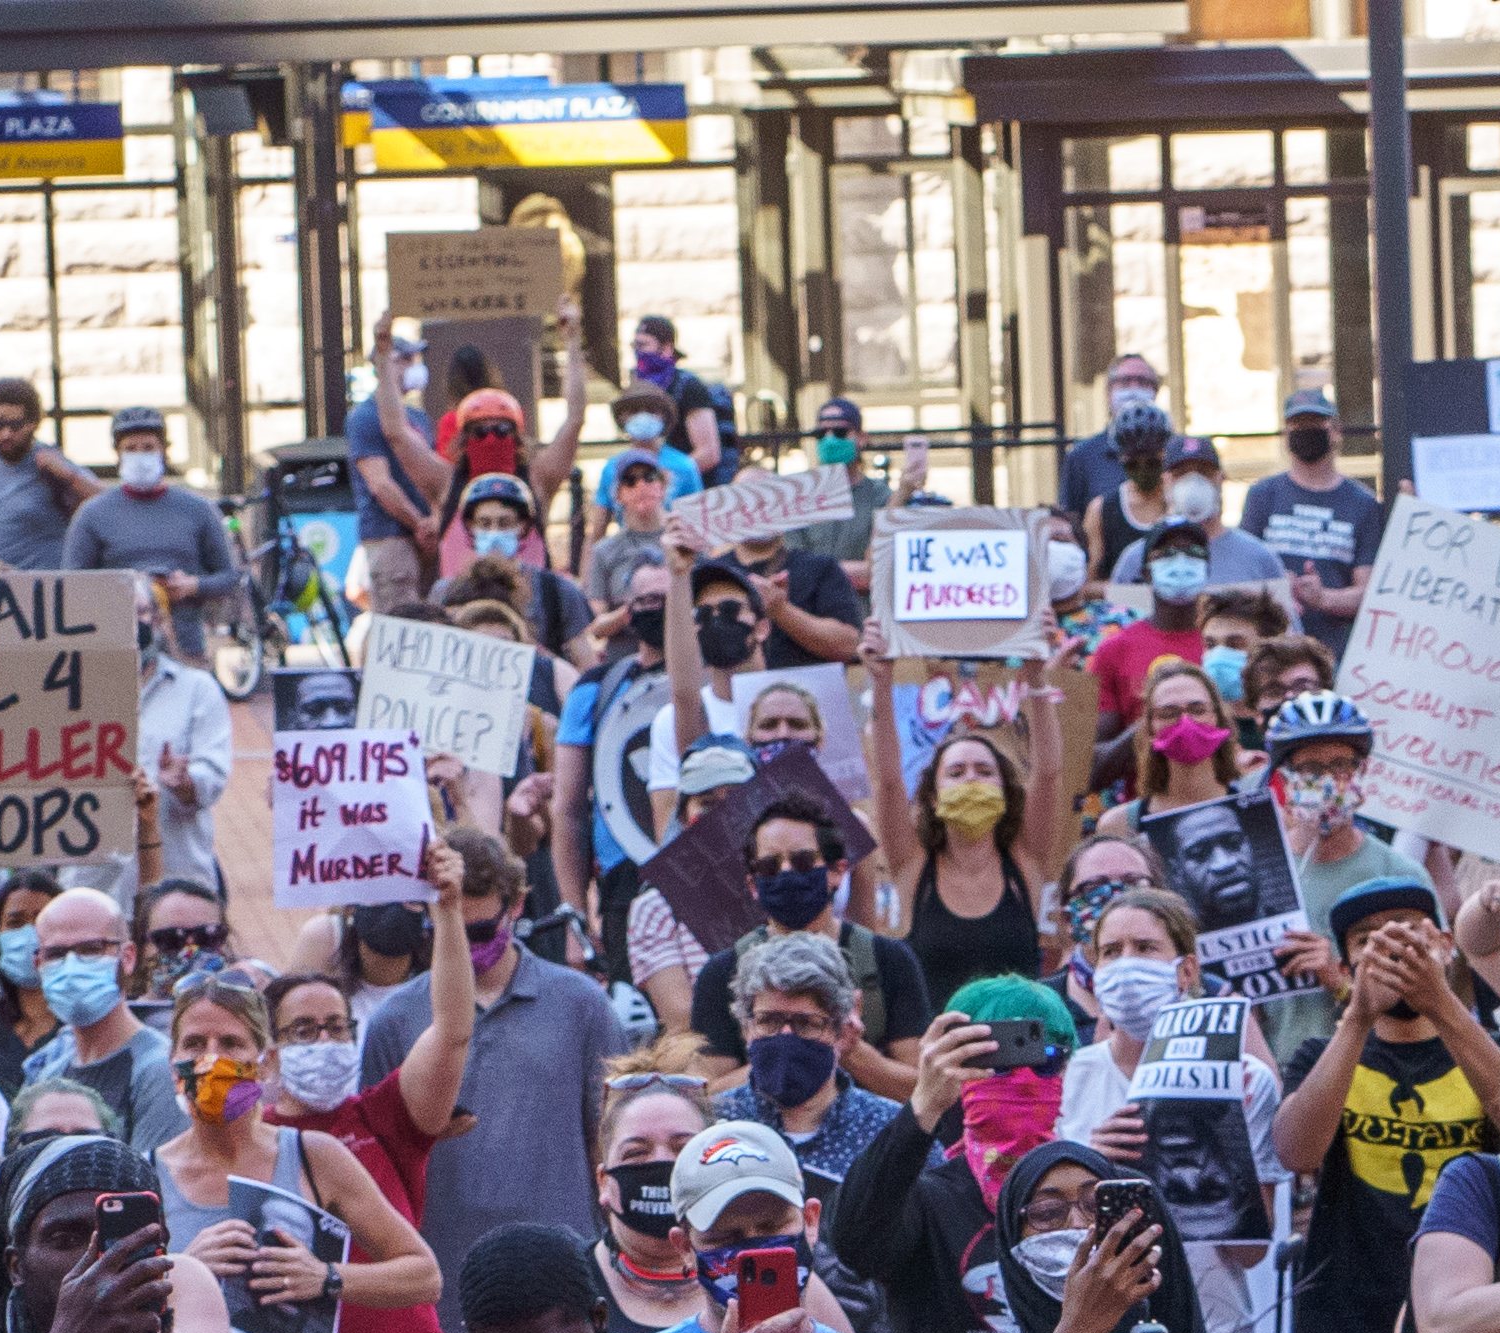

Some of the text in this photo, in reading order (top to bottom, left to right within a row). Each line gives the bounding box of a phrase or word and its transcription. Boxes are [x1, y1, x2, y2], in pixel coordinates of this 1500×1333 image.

[569, 95, 640, 119] PLAZA
[4, 115, 76, 139] PLAZA
[907, 537, 1008, 573] HE WAS
[1401, 510, 1474, 567] FOR
[905, 582, 1020, 612] MURDERED
[373, 621, 528, 692] WHO POLICES
[43, 650, 83, 711] 4
[1350, 663, 1495, 731] SOCIALIST
[369, 693, 495, 762] POLICE?
[298, 796, 388, 831] it was
[1199, 920, 1298, 957] USTICE
[1230, 955, 1270, 973] FOR
[1153, 1003, 1239, 1037] FLOYD
[1172, 1040, 1201, 1056] FOR
[1136, 1066, 1232, 1091] JUSTICE
[630, 1199, 674, 1215] PREVEN
[640, 1185, 671, 1200] THIS
